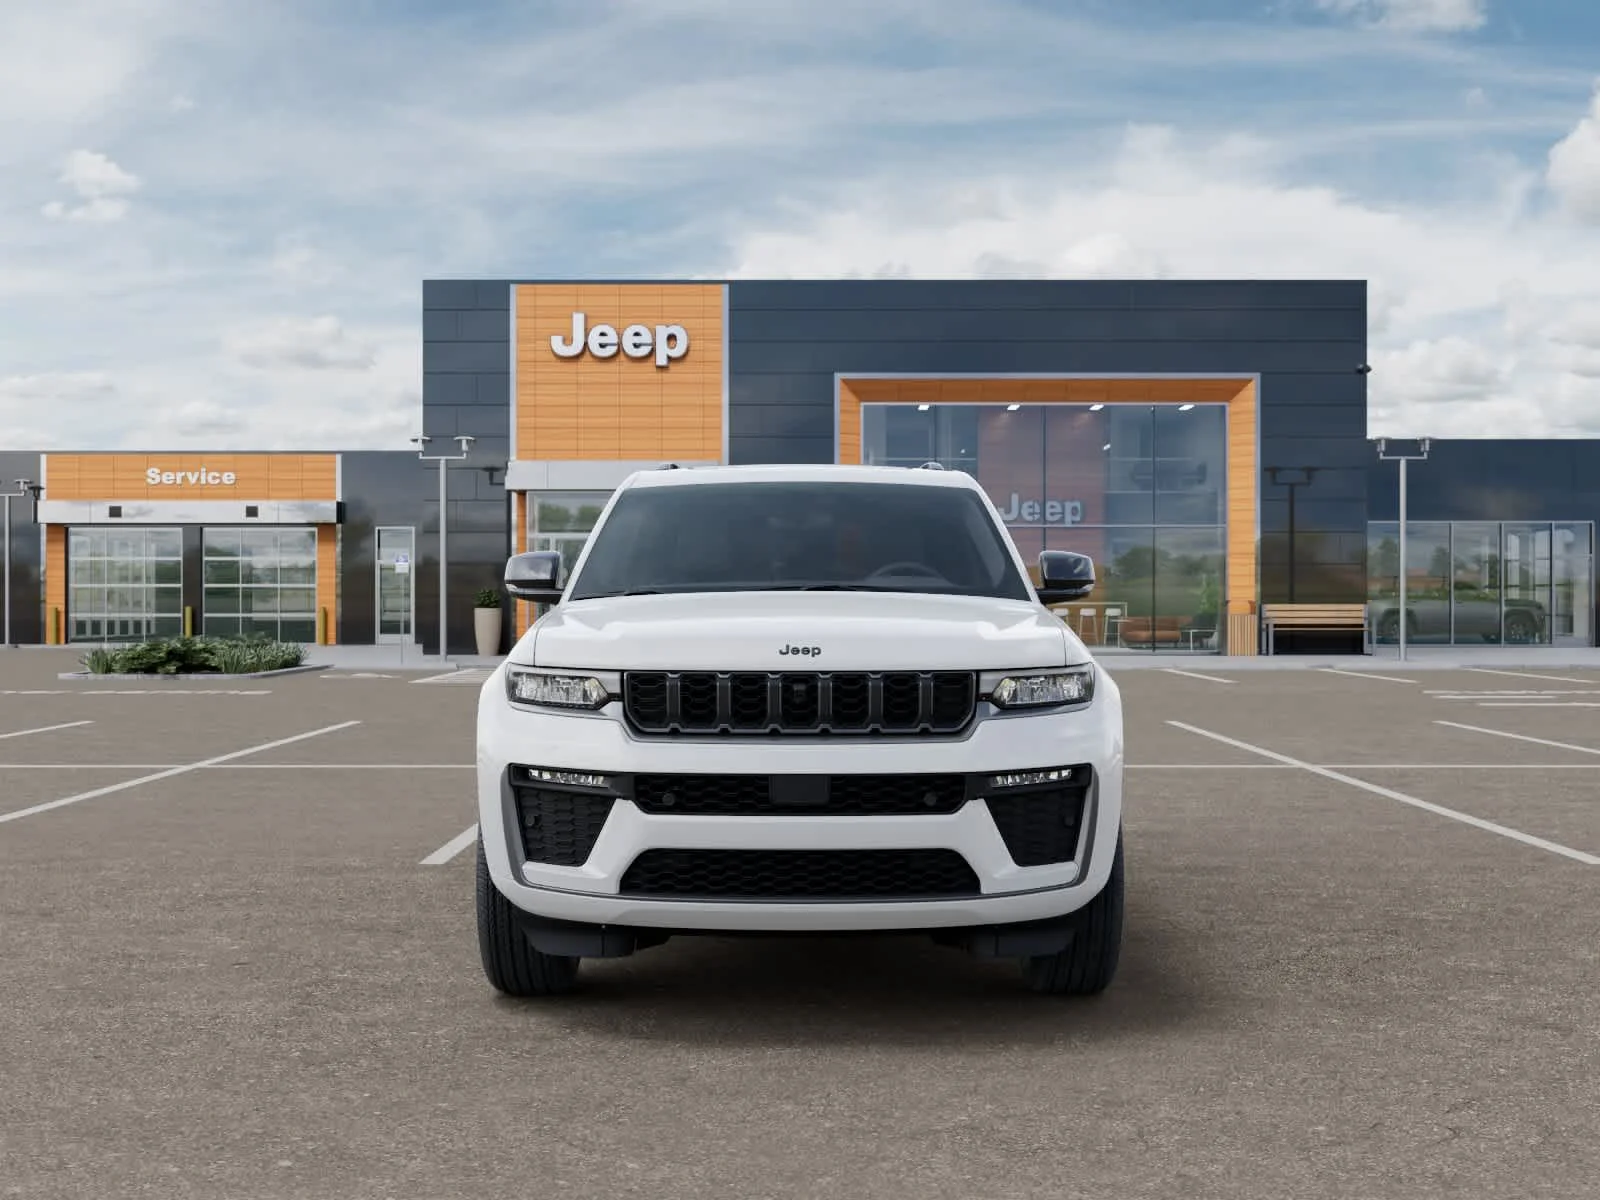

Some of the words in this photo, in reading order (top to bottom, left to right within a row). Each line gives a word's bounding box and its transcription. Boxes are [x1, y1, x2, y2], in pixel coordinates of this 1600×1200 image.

[550, 312, 689, 367] Jeep
[146, 466, 237, 485] Service
[998, 493, 1082, 526] Jeep
[779, 644, 821, 657] Jeep
